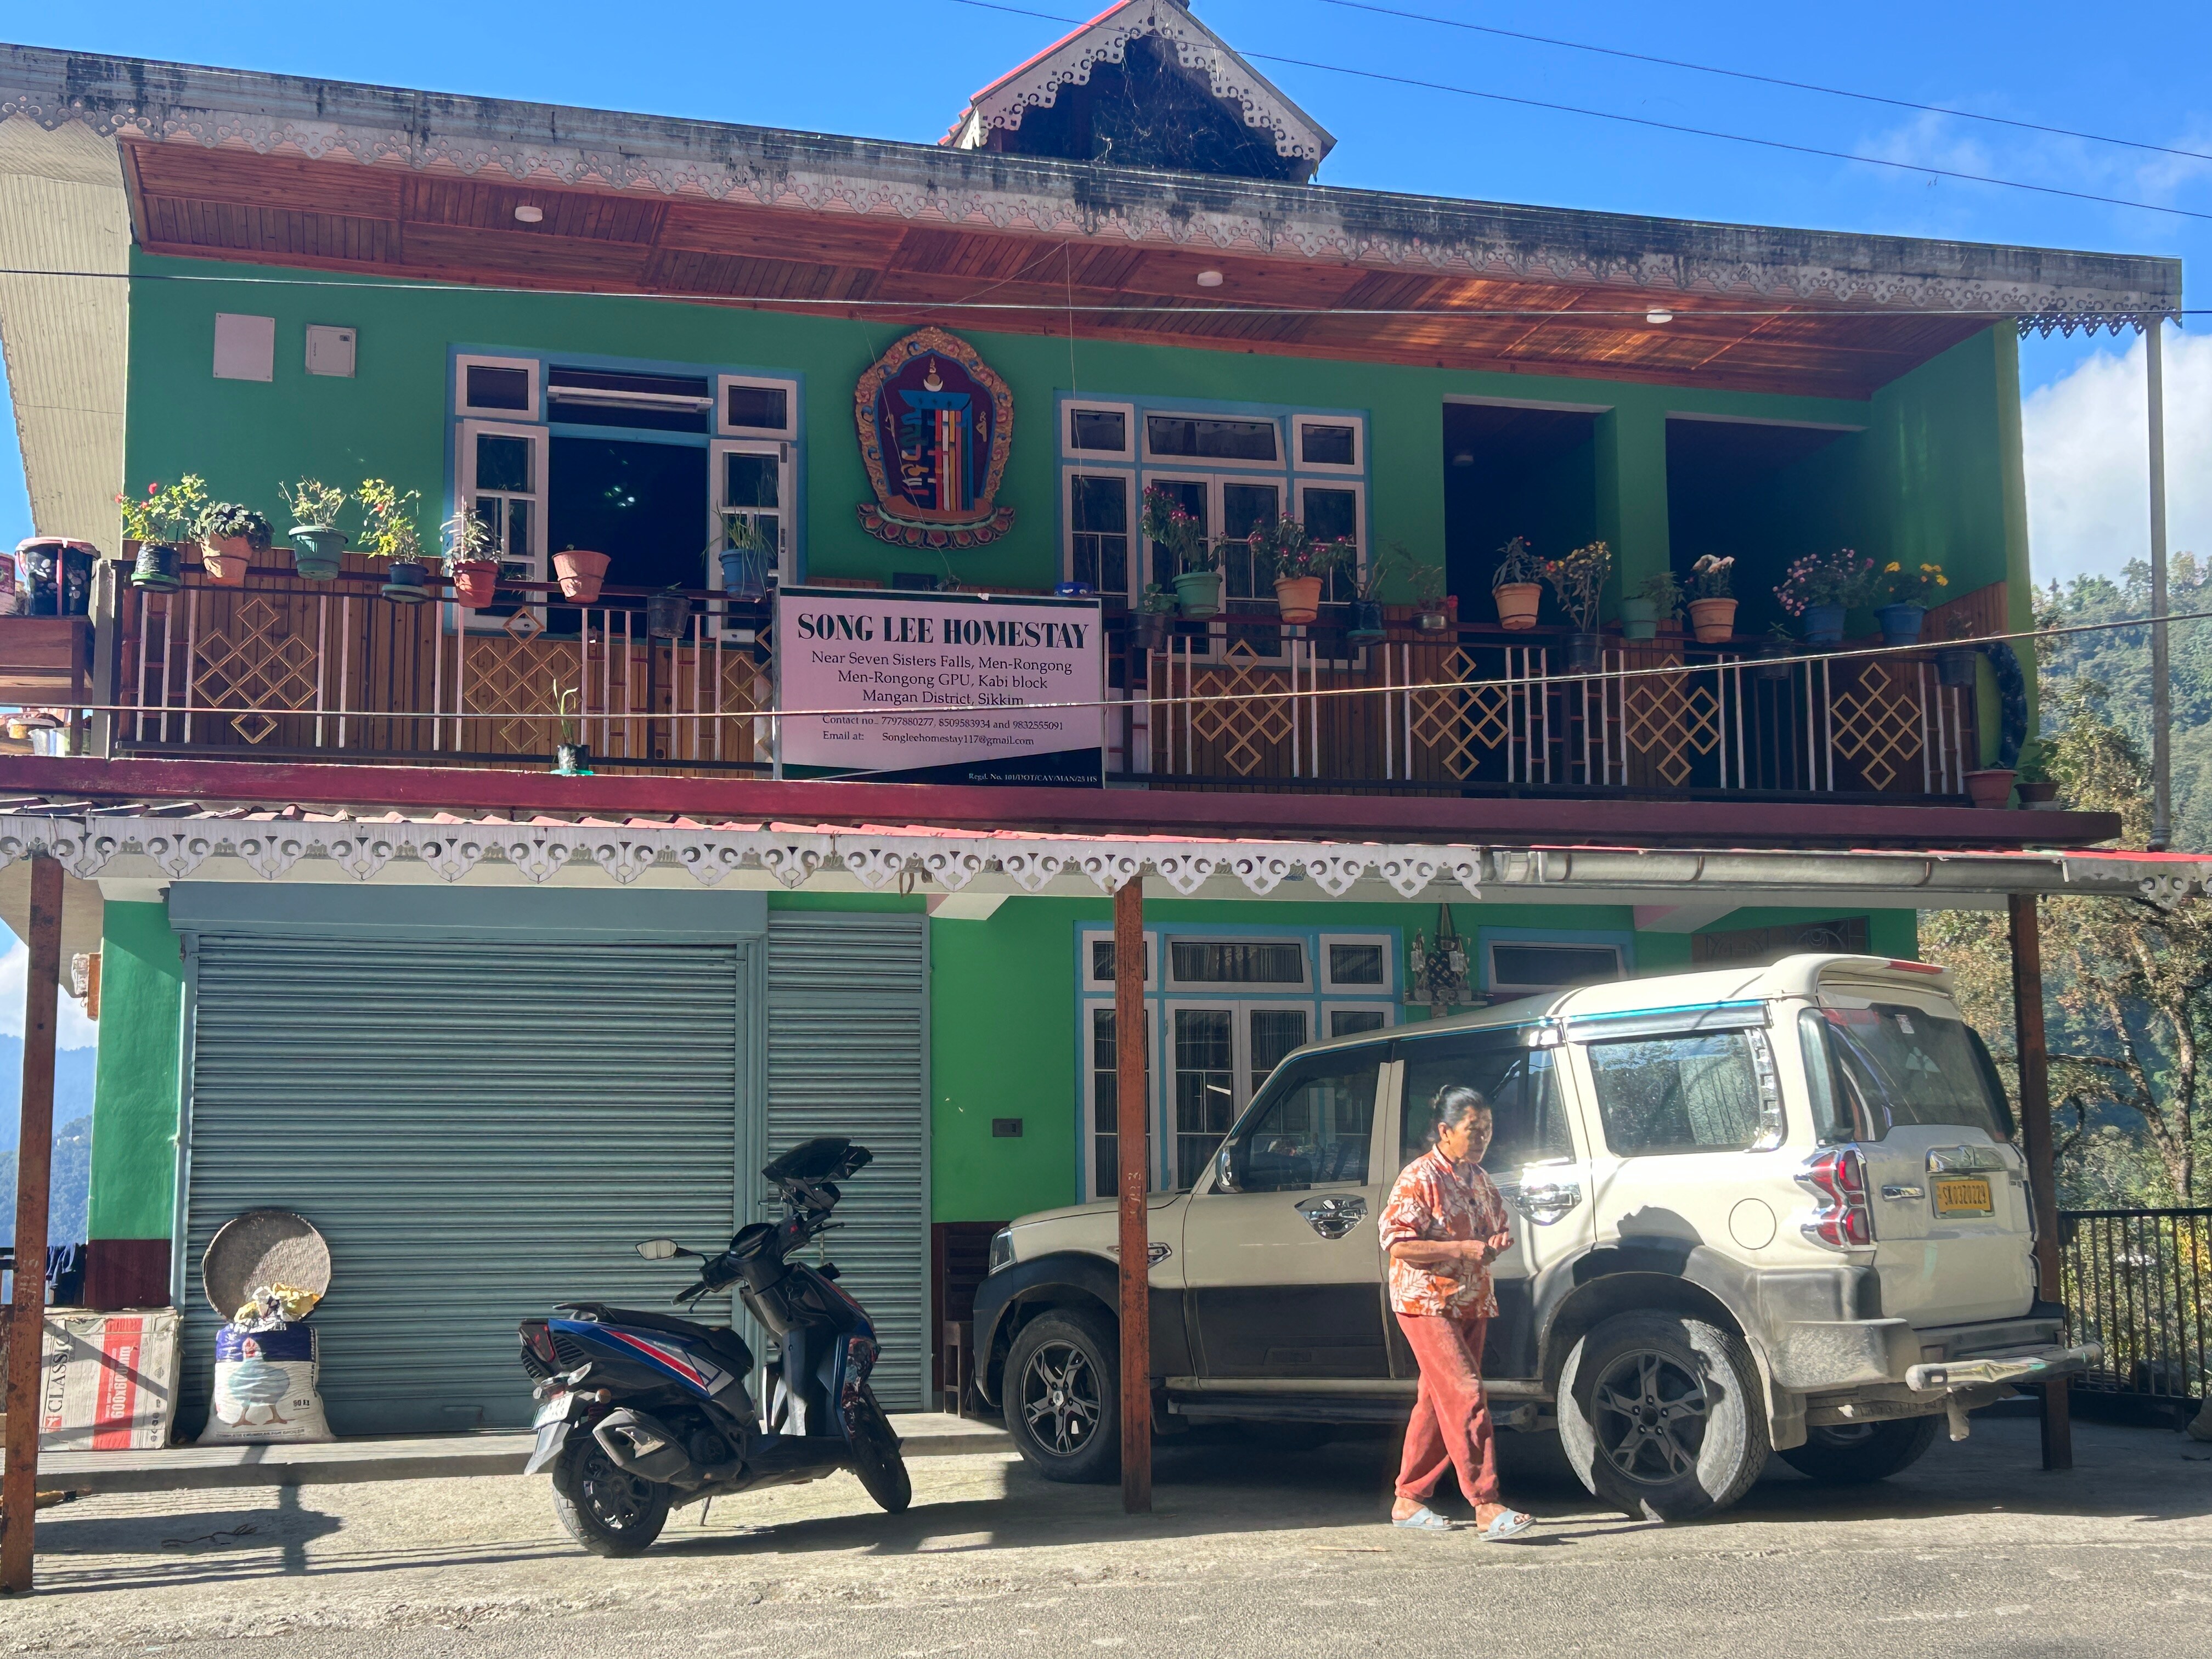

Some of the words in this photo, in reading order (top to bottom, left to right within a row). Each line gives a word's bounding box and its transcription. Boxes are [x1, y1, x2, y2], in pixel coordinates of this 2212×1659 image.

[798, 613, 873, 641] SONG
[883, 616, 934, 644] LEE
[943, 619, 1089, 648] HOMESTAY
[812, 651, 845, 663] Near
[849, 652, 889, 665] Seven
[893, 653, 936, 667] Sisters
[940, 656, 974, 670] Falls,
[979, 657, 1072, 675] Men-Rongong
[838, 670, 934, 689] Men-Rongong
[939, 674, 974, 687] GPU,
[979, 675, 1008, 687] Kabi
[1013, 675, 1048, 689] block
[863, 689, 918, 706] Mangan
[923, 691, 974, 706] District,
[978, 693, 1024, 706] Sikkim
[822, 715, 859, 725] Contact
[993, 720, 1010, 729] and
[823, 731, 849, 740] Email
[882, 732, 1034, 746] Songleehomestay117@gmail.com
